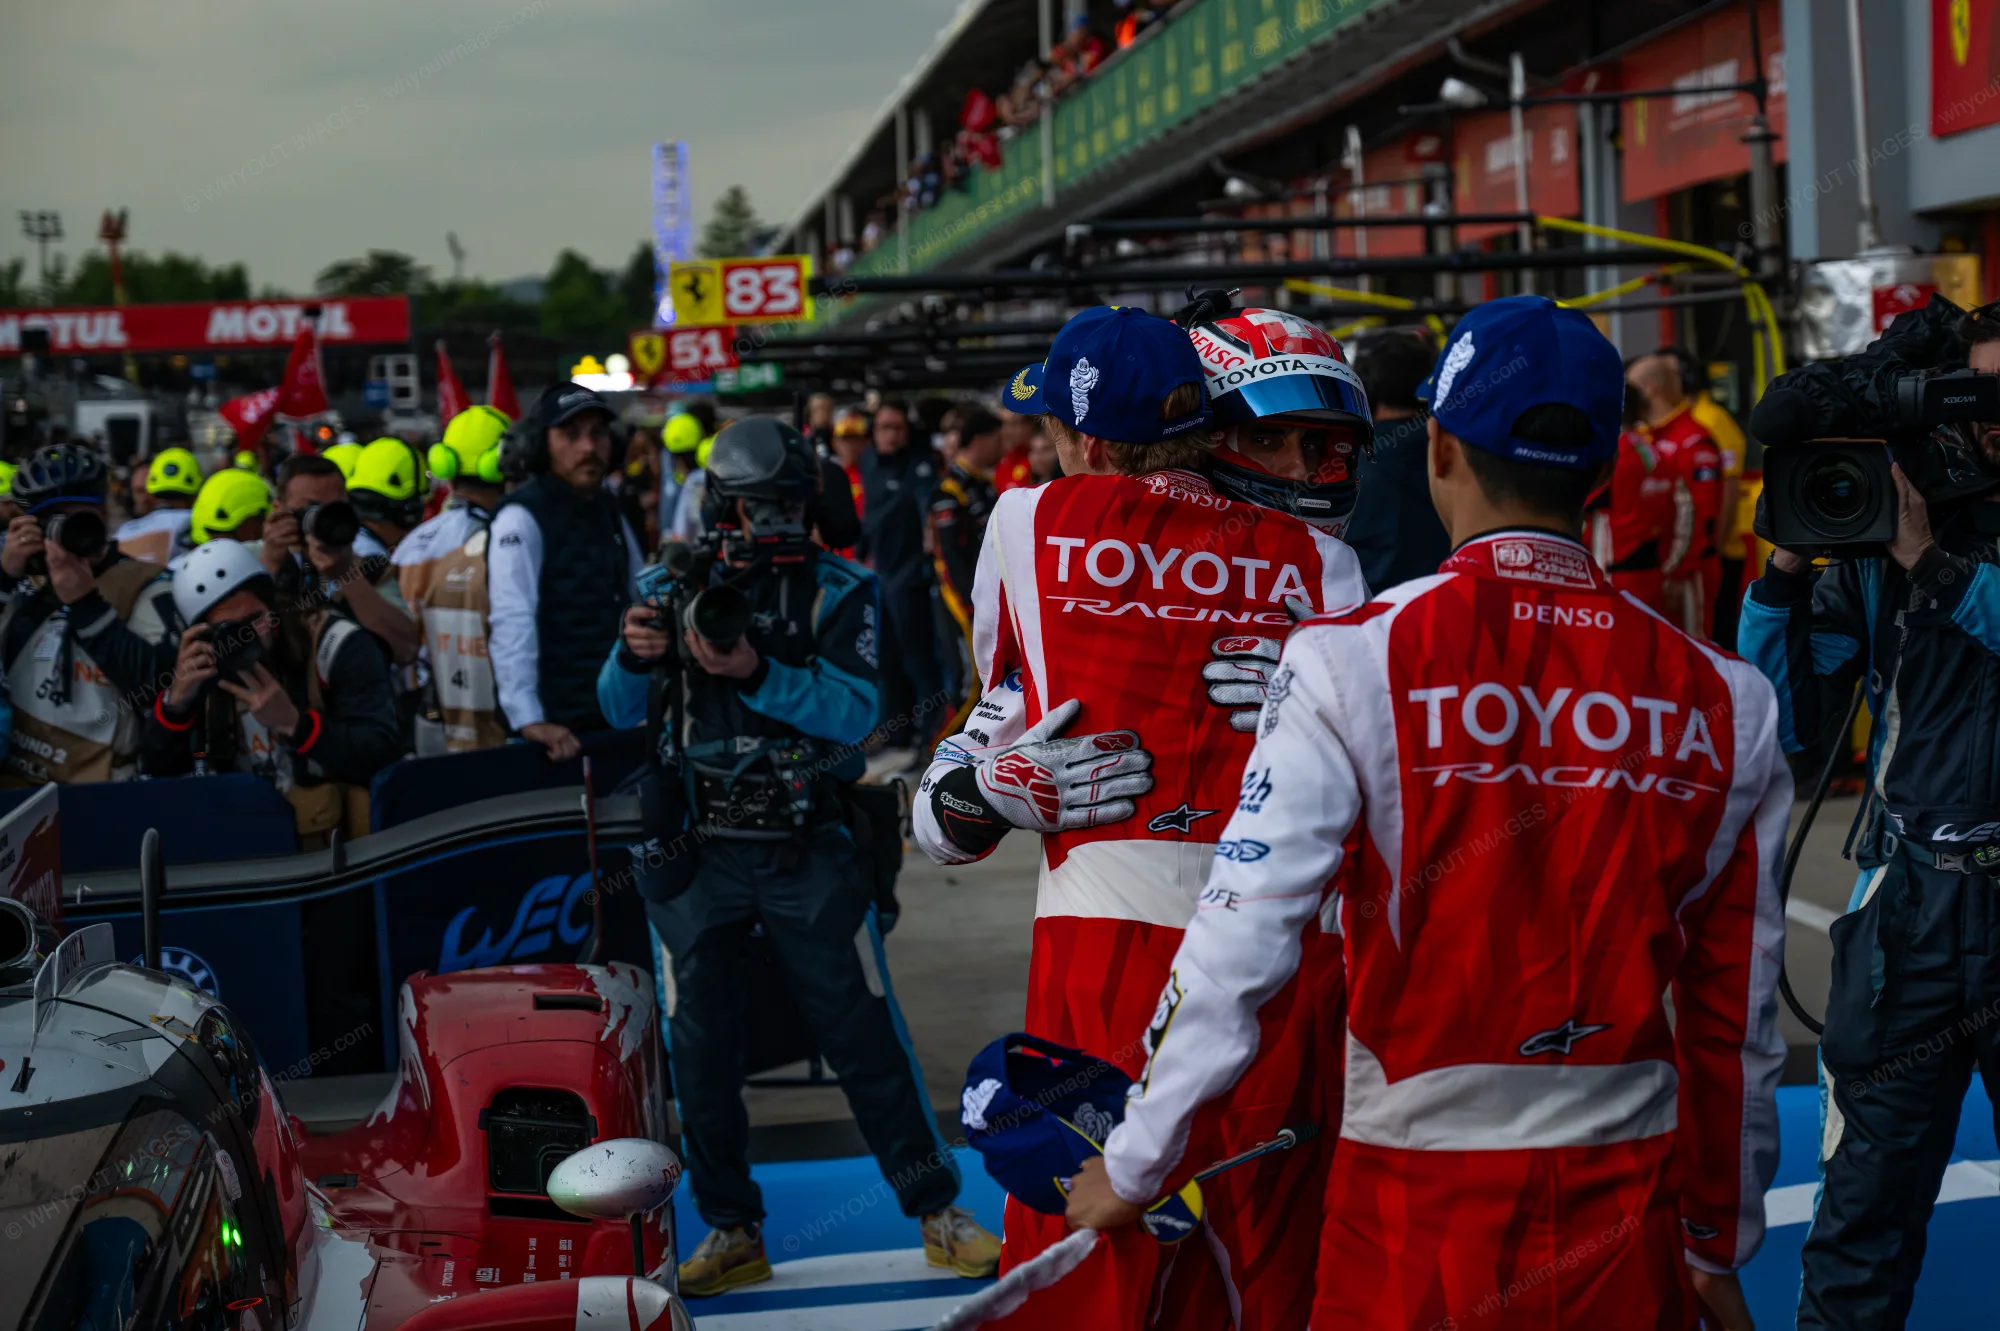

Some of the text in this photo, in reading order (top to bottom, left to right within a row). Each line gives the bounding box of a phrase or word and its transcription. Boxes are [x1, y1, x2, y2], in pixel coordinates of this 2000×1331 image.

[725, 265, 800, 315] 83
[669, 329, 729, 370] 51
[1213, 359, 1309, 390] TOYOTA
[1943, 395, 1977, 404] XDCAM
[1162, 417, 1205, 435] MICHELIN
[1514, 446, 1578, 464] MICHELIN
[1150, 483, 1232, 511] DENSO
[1499, 546, 1531, 564] FIA
[1046, 536, 1313, 608] TOYOTA
[1045, 595, 1294, 625] RACING
[1512, 600, 1615, 630] DENSO
[977, 700, 1004, 713] JAPAN
[1408, 681, 1724, 773] TOYOTA
[1412, 763, 1720, 801] RACING
